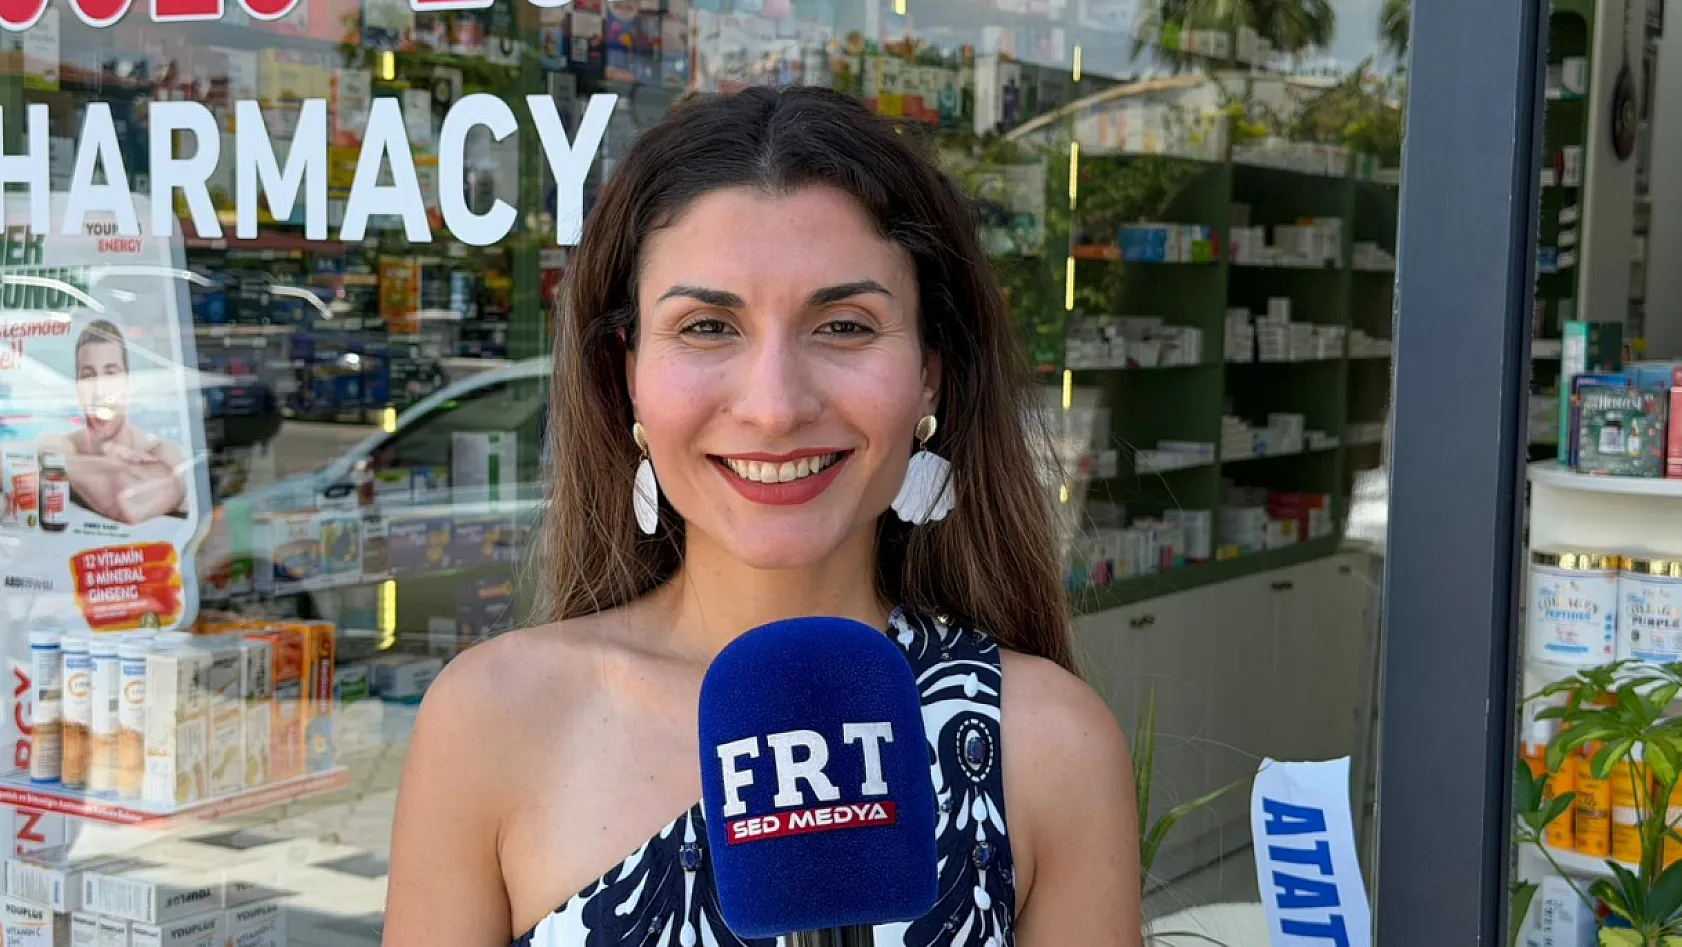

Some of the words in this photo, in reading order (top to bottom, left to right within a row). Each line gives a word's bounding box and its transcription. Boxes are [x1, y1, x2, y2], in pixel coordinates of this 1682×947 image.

[98, 238, 142, 253] ENERGY
[83, 554, 96, 569] 12
[86, 571, 95, 587] 8
[717, 722, 894, 817] FRT
[732, 815, 781, 839] SED
[788, 804, 888, 830] MEDYA
[1262, 796, 1350, 947] ATAT
